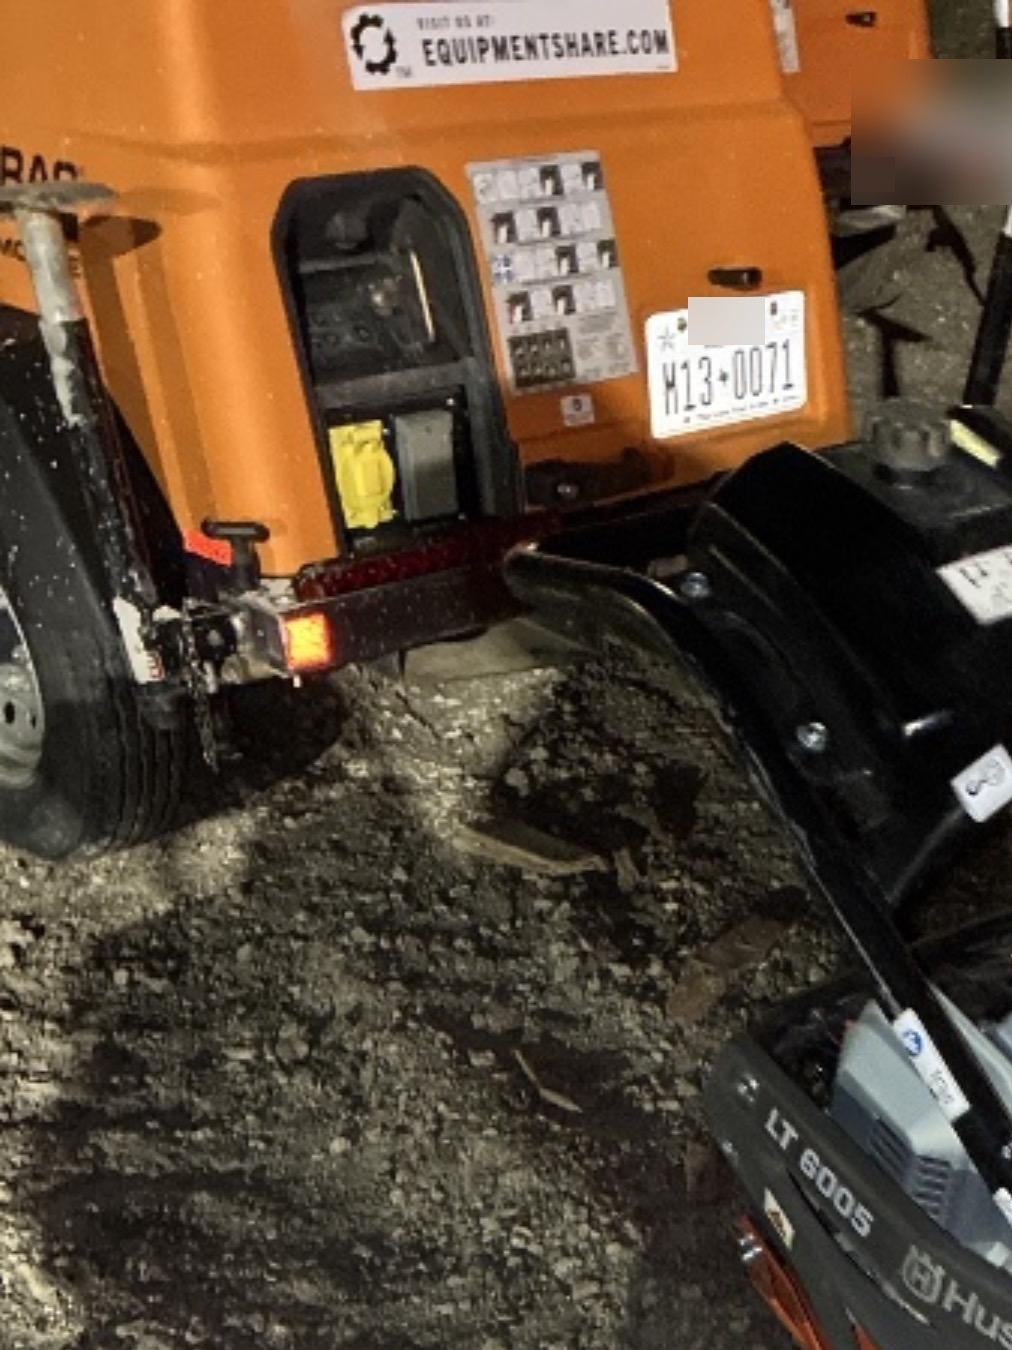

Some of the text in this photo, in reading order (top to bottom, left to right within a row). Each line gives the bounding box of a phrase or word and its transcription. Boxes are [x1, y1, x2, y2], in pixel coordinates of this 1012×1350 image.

[421, 28, 670, 67] EQUIPMENTSHARE.COM
[764, 1106, 799, 1150] LT
[800, 1147, 875, 1238] 6005
